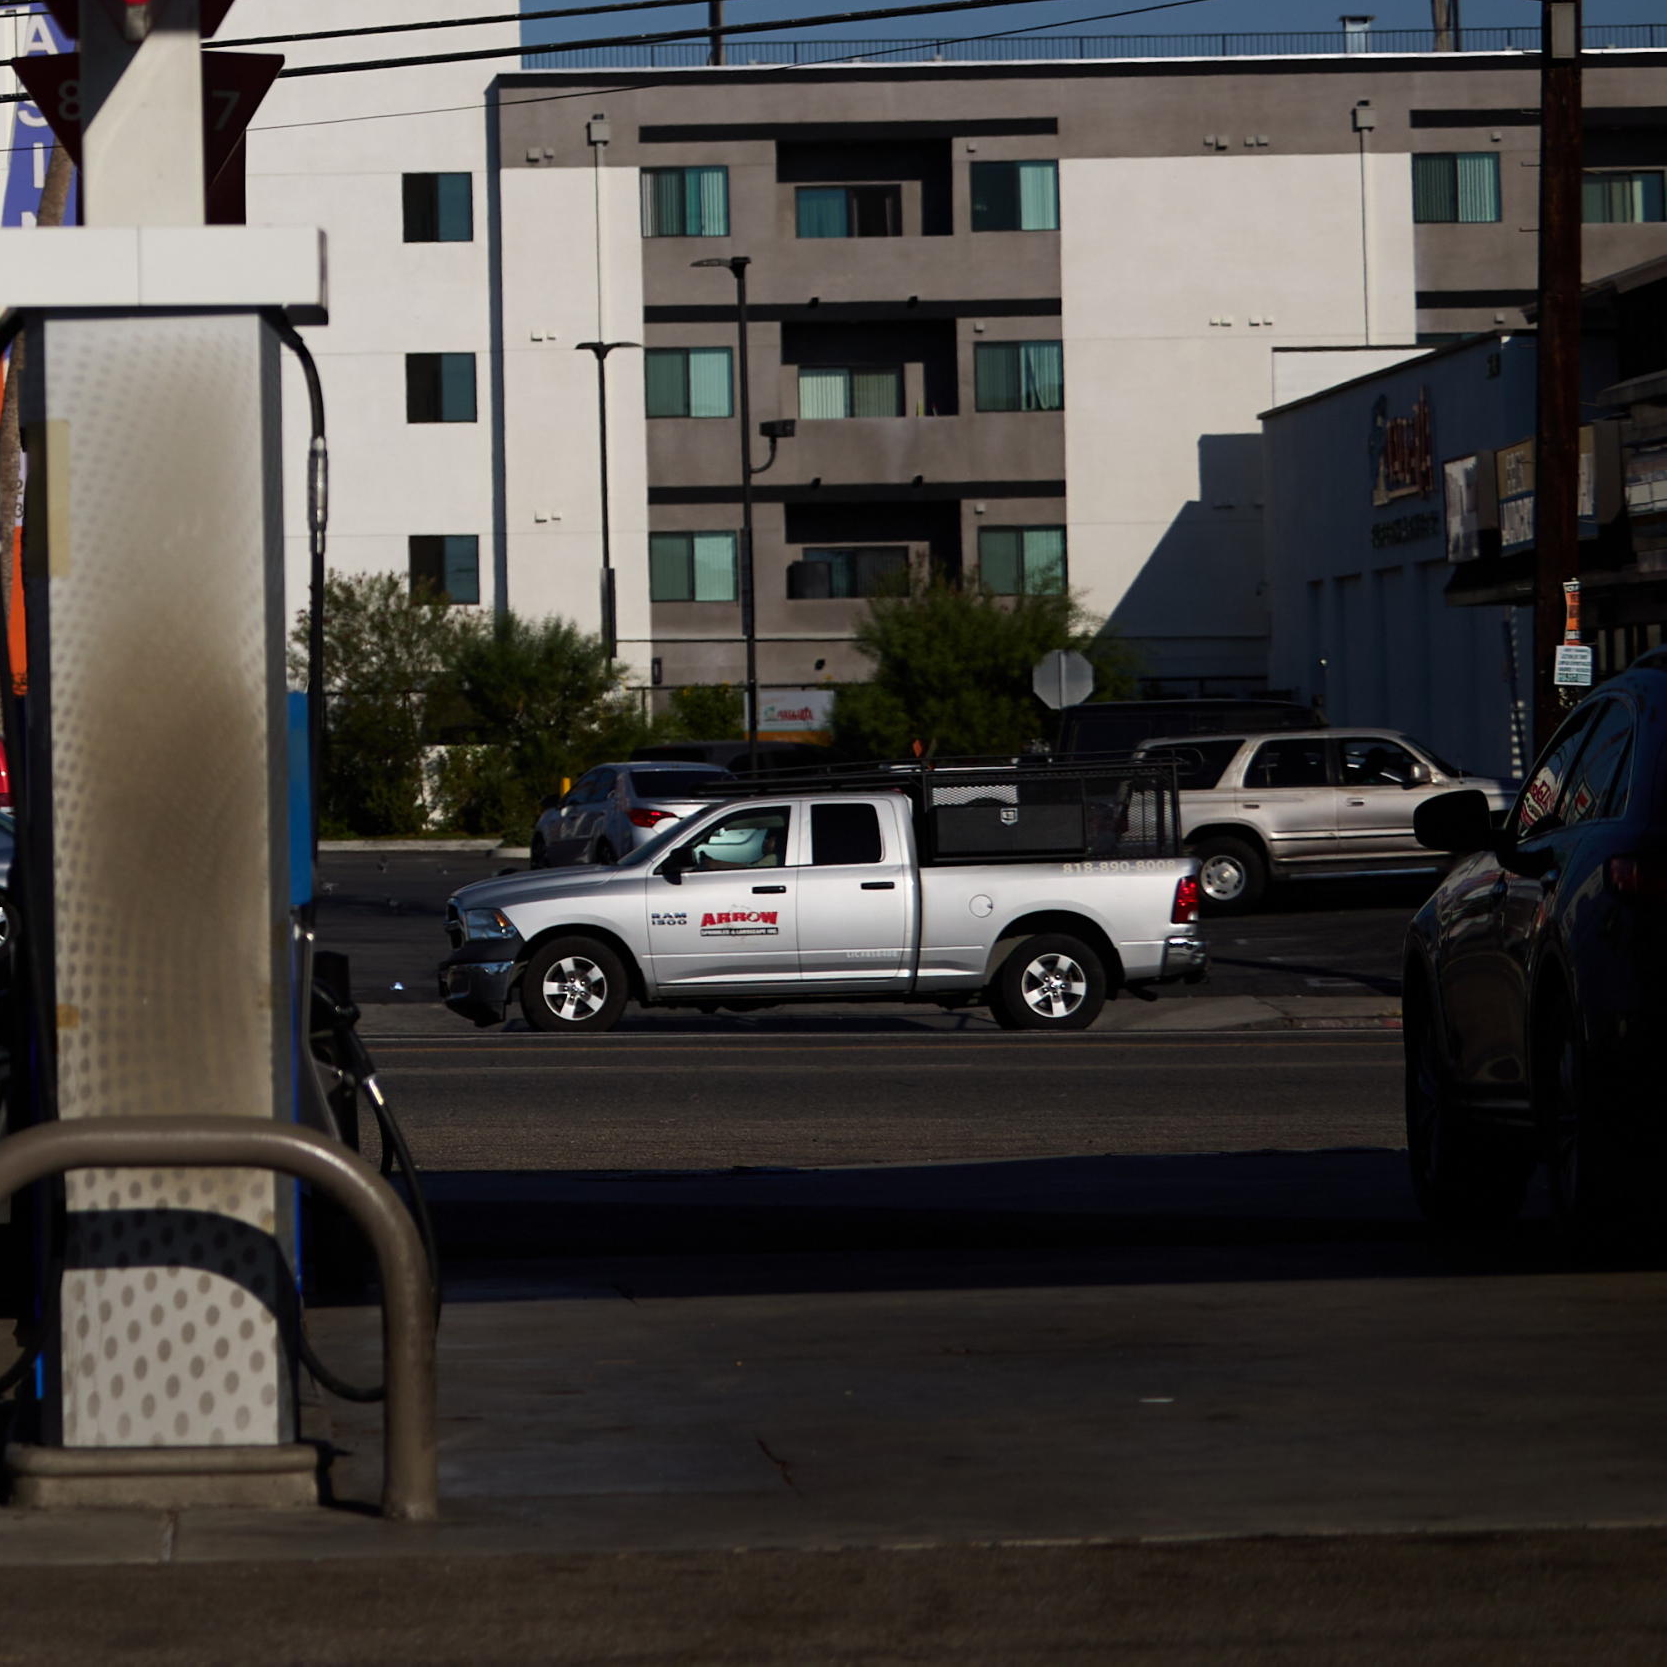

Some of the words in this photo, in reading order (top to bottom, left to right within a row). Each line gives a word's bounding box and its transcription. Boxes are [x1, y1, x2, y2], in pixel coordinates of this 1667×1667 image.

[58, 79, 83, 120] 8
[211, 91, 241, 131] 7
[1063, 860, 1176, 873] 818-890-8008
[700, 911, 778, 927] ARROW
